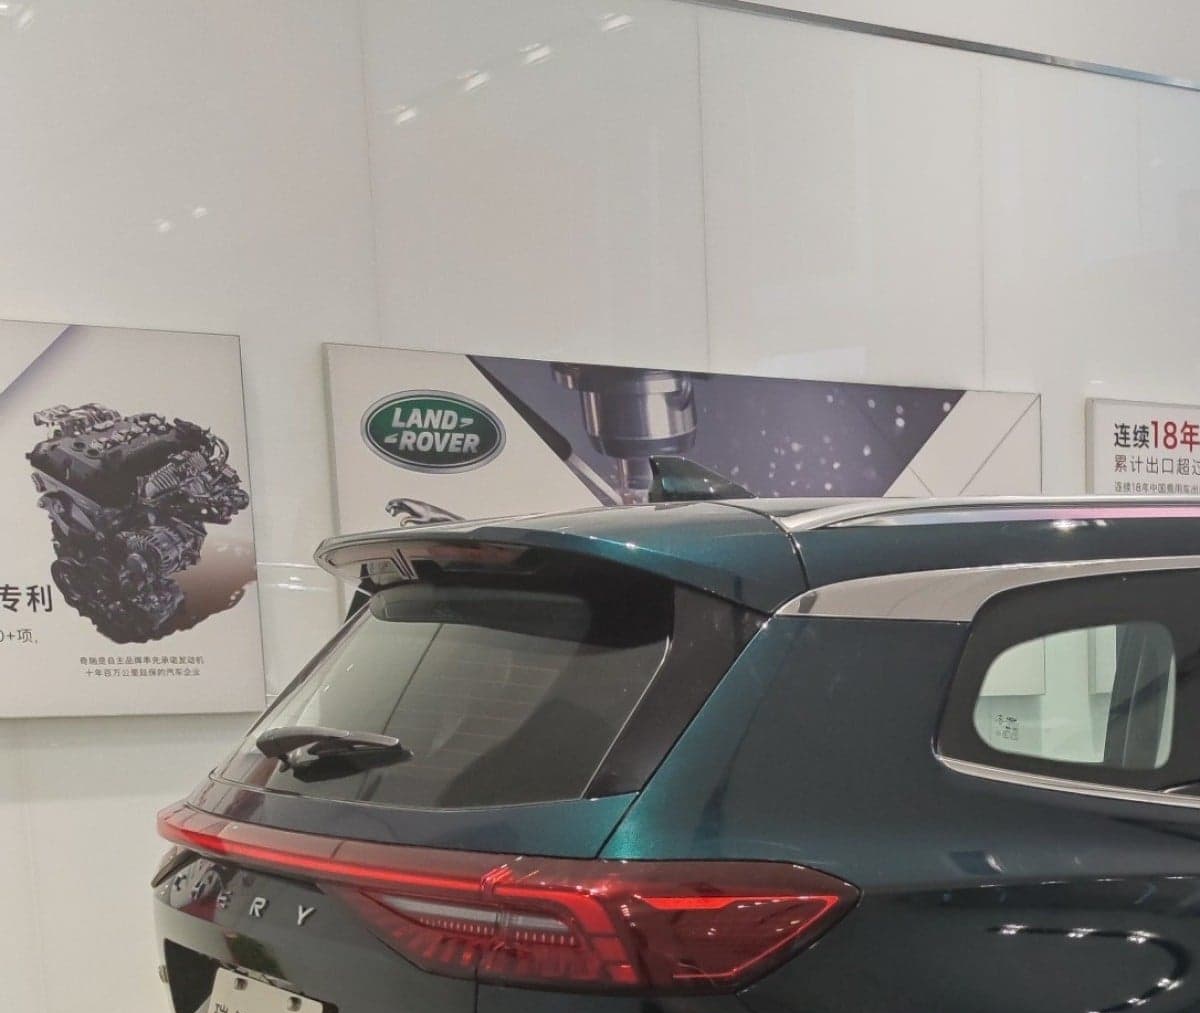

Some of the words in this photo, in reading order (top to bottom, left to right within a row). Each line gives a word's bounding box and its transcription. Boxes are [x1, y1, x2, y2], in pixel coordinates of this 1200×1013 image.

[391, 407, 458, 430] LAND
[398, 430, 480, 453] ROVER
[0, 584, 53, 613] 专利
